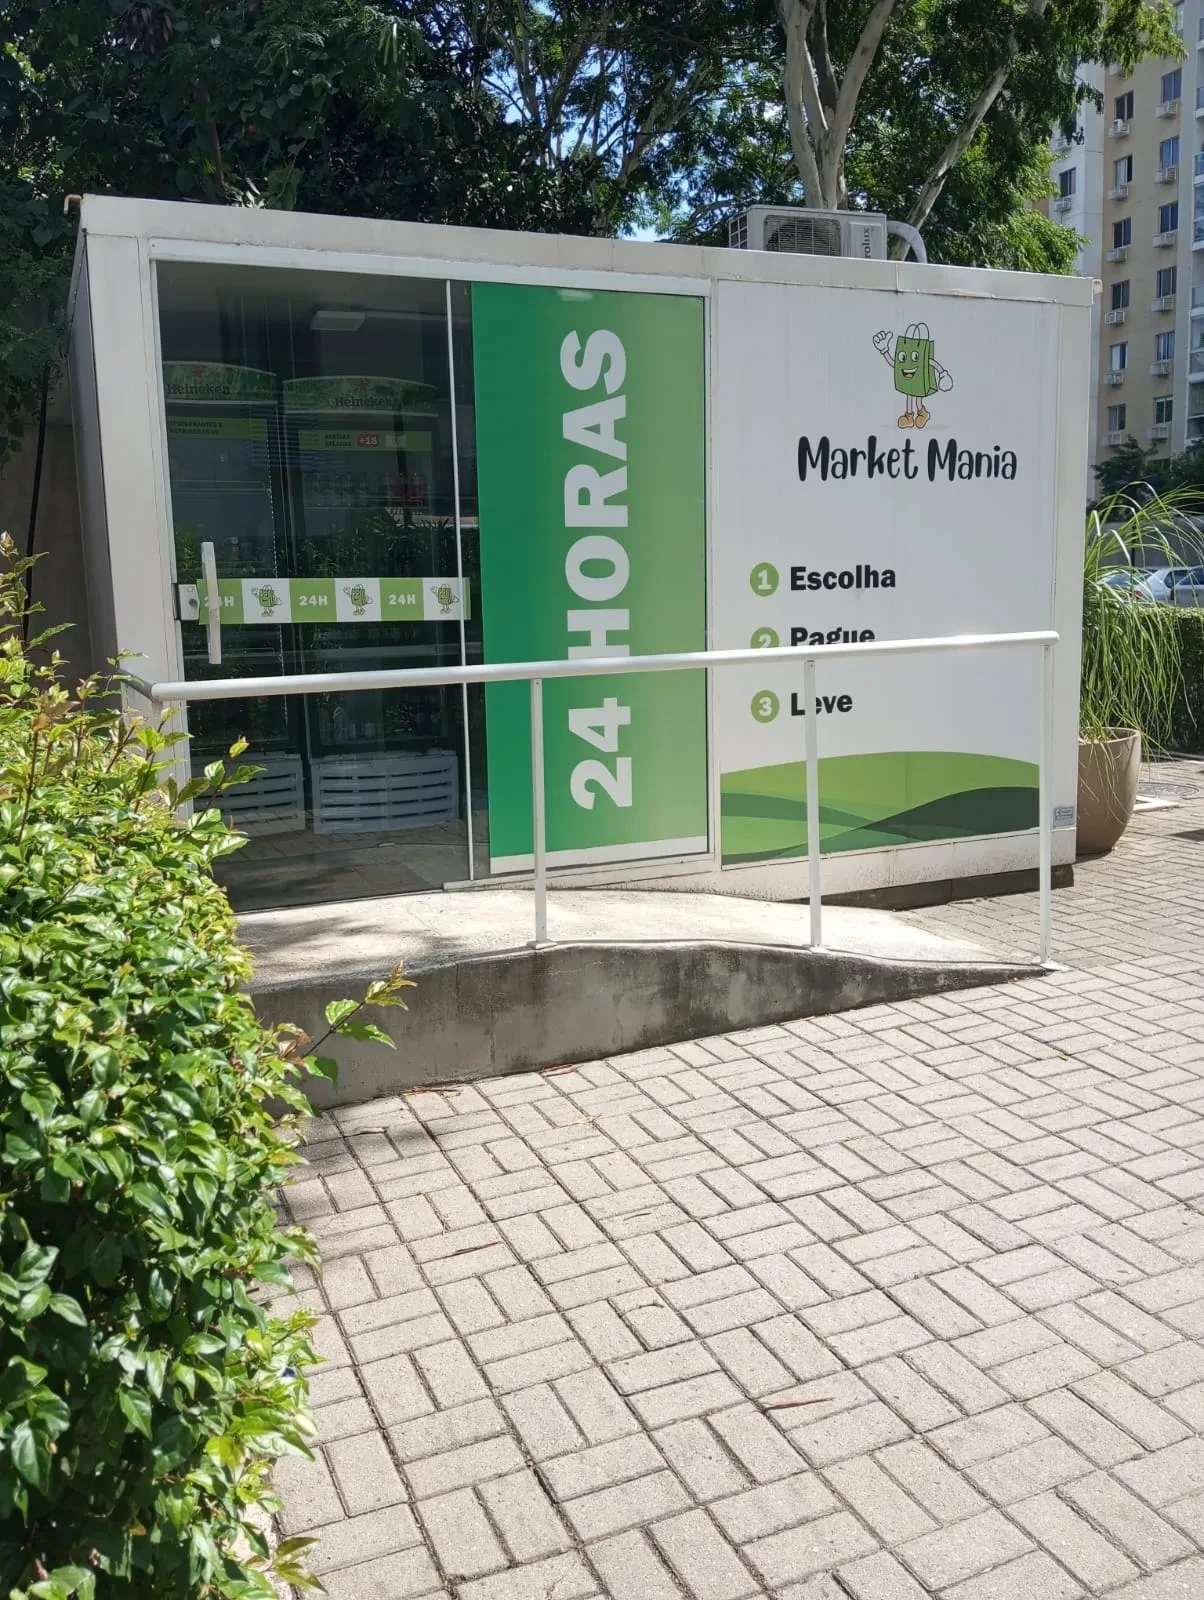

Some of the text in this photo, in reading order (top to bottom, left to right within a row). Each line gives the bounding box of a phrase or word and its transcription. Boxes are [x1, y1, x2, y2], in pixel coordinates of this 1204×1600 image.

[797, 435, 1018, 482] Market Mania
[560, 329, 633, 810] 24 HORAS
[757, 564, 896, 590] 1 Escolha
[299, 594, 329, 607] 24H
[388, 593, 416, 605] 24H
[758, 696, 773, 717] 3
